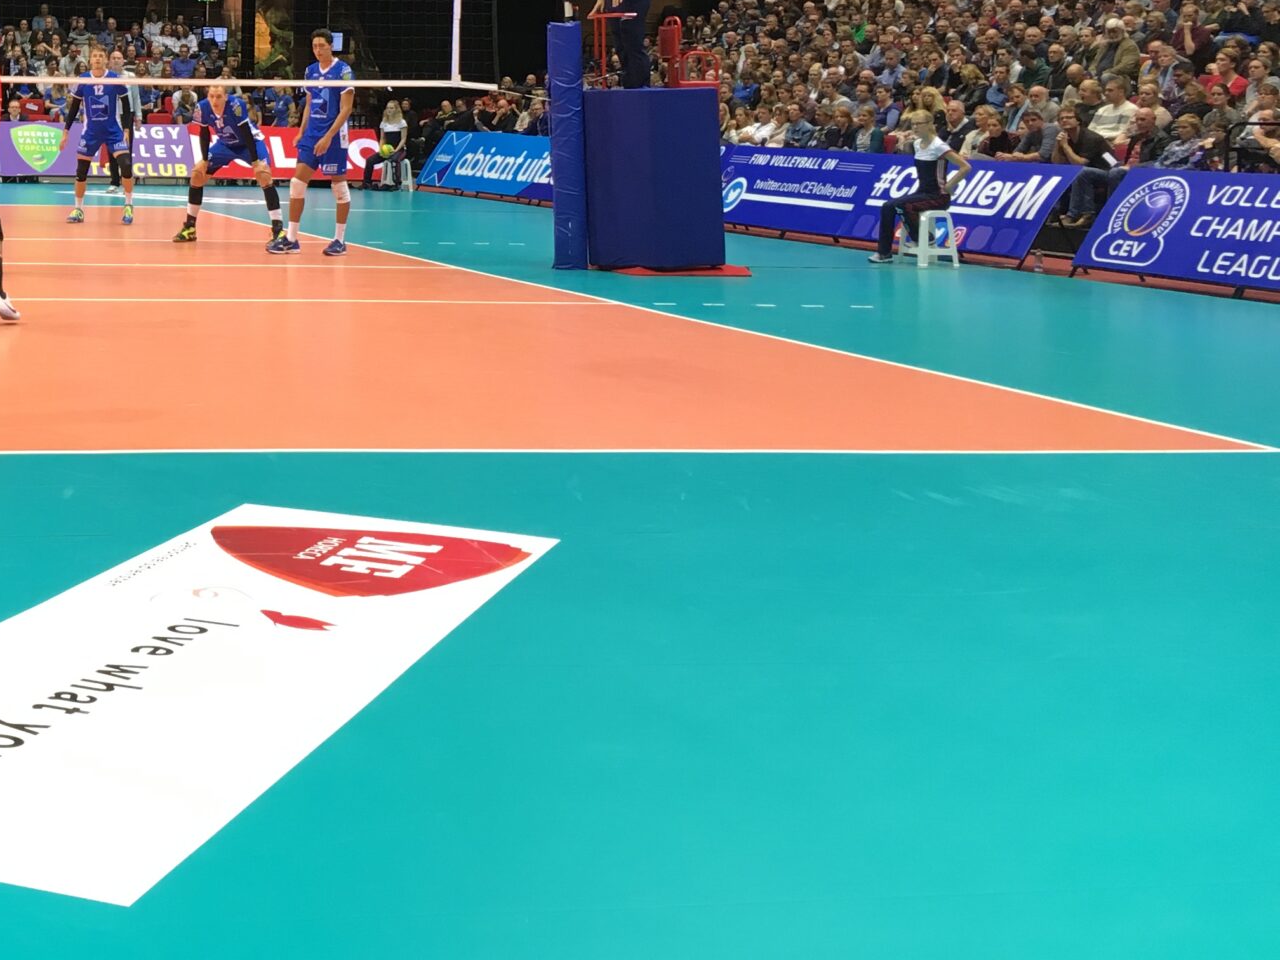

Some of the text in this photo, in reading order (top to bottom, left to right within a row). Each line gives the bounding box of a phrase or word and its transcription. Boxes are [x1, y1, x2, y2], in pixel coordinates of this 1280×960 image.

[93, 85, 104, 95] 12
[455, 146, 527, 181] abiant
[748, 154, 839, 171] FIND VOLLEYBALL ON
[753, 178, 858, 199] twitter.com/CEVolleyball
[871, 165, 1062, 220] #ColleyM
[1112, 187, 1151, 234] VOLLEYBALL
[1151, 203, 1183, 238] LEAGUE
[1109, 239, 1147, 258] CEV
[292, 537, 347, 559] HORECA
[131, 617, 240, 656] love
[32, 664, 148, 714] what
